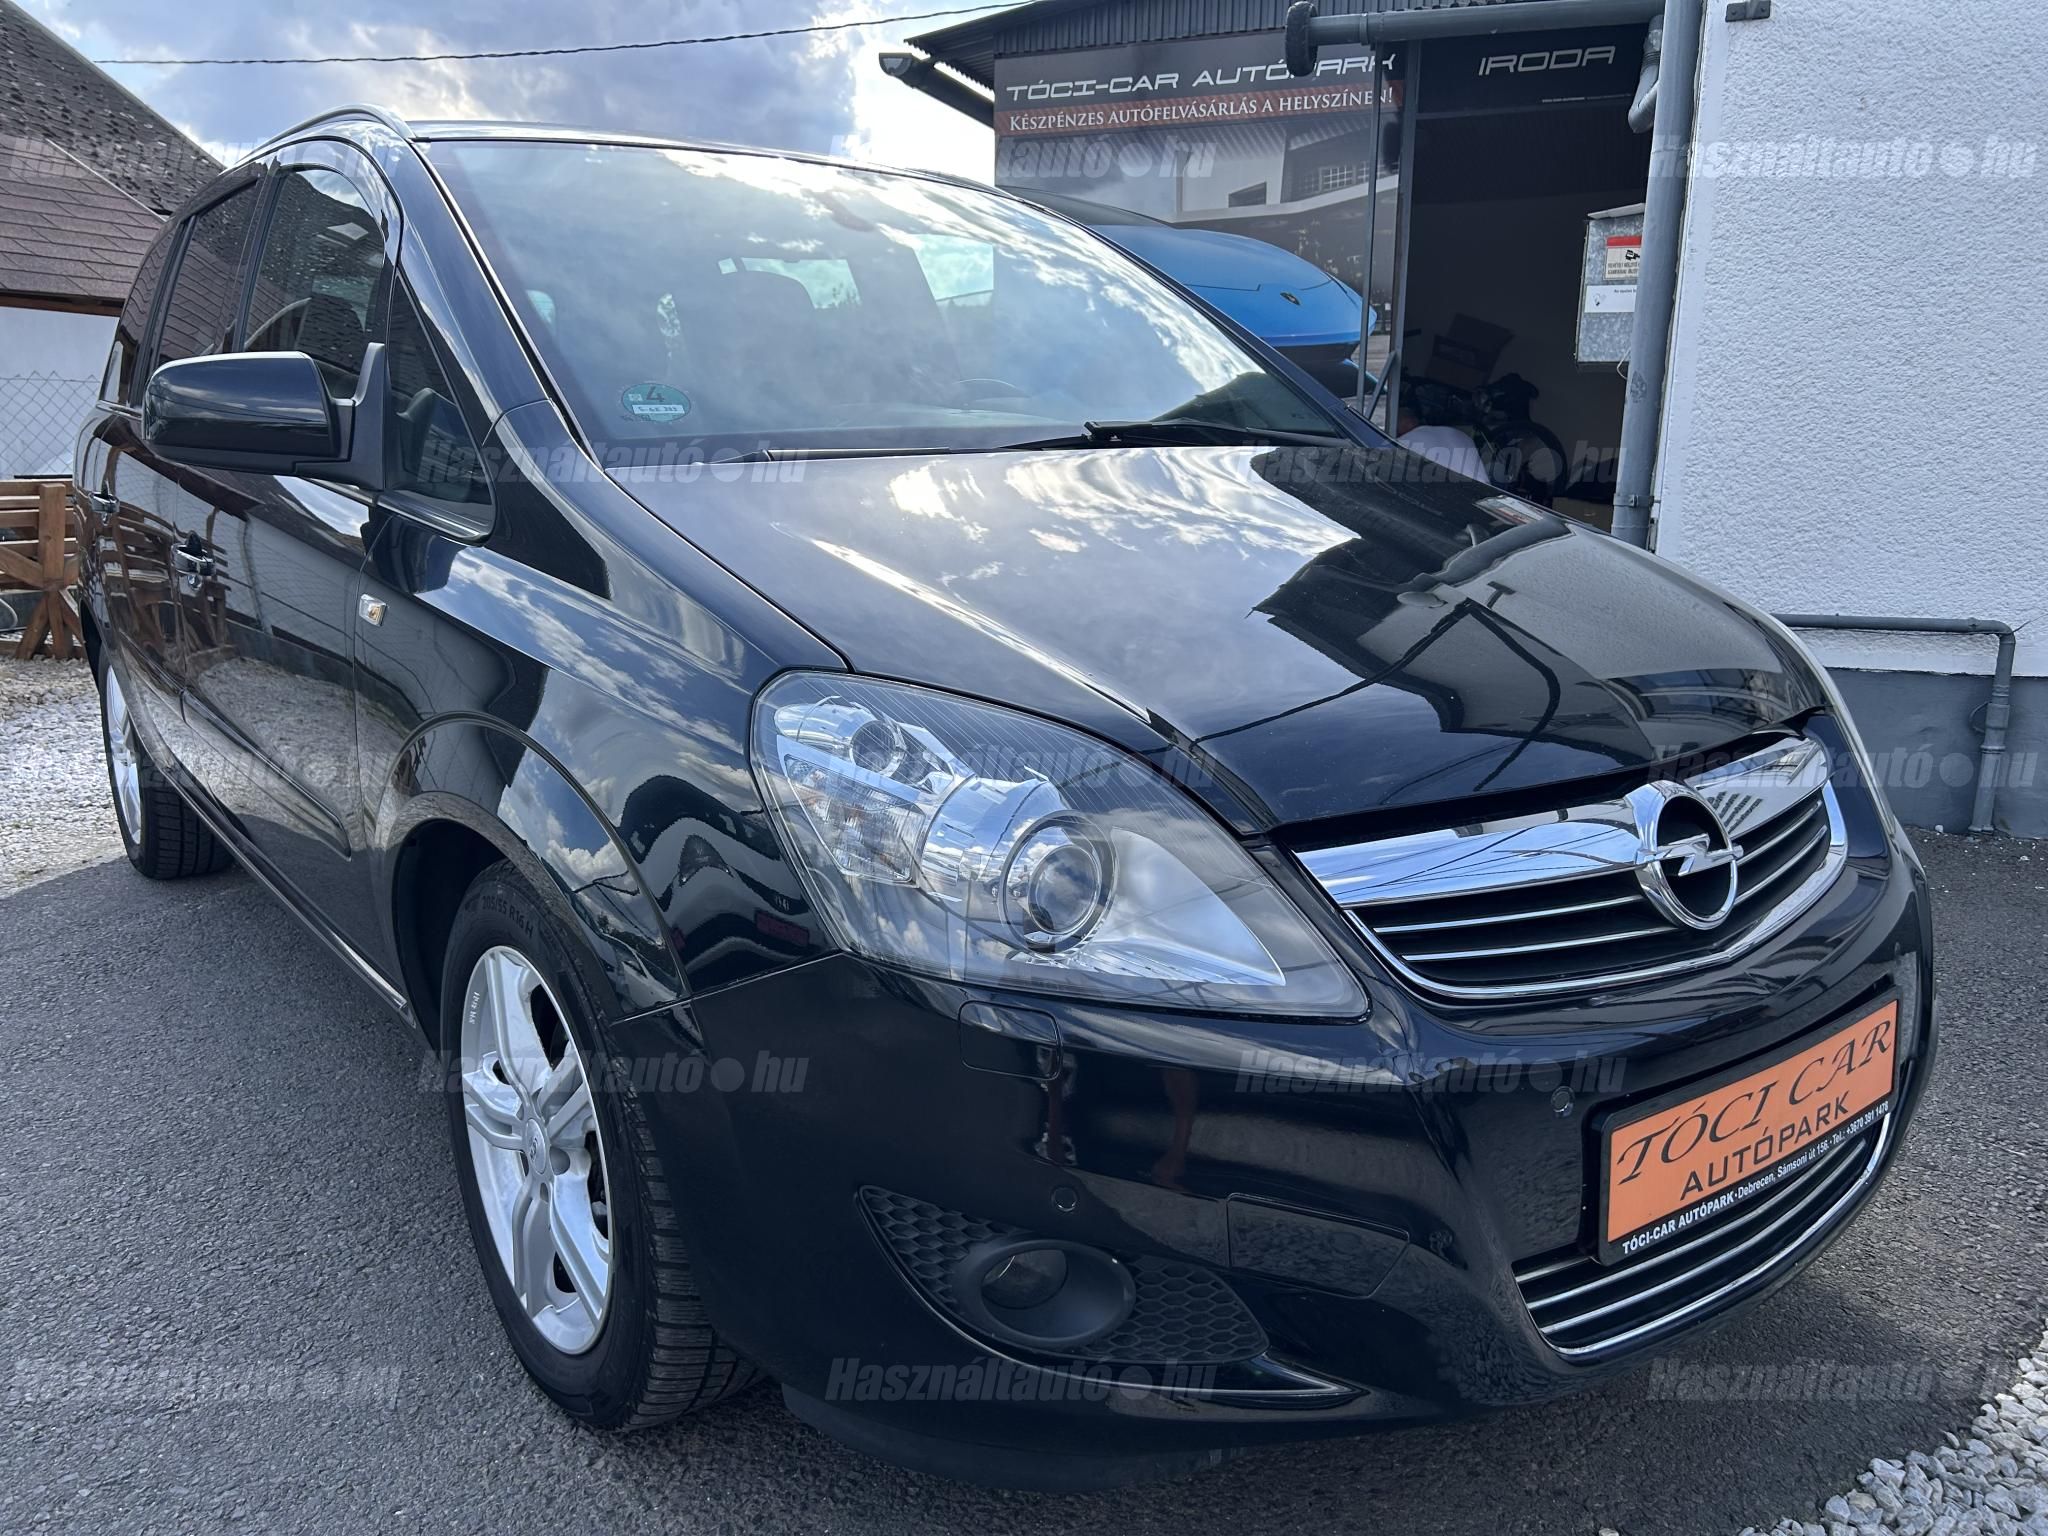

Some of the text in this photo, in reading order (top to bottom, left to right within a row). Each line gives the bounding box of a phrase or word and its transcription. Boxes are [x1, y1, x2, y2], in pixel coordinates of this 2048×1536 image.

[1006, 54, 1396, 101] TÓCI-CAR AUTÓARK
[1478, 45, 1616, 76] IRODA
[1010, 110, 1104, 131] KÉSZPÉNZES
[1108, 97, 1257, 124] AUTÓFELVÁSÁRLÁS
[1262, 98, 1273, 113] A
[646, 385, 665, 403] 4
[1616, 1020, 1892, 1186] TÓCI CAR
[1680, 1091, 1849, 1201] AUTÓPARK
[1622, 1219, 1676, 1254] TÓCI-CAR
[1808, 1147, 1816, 1161] út
